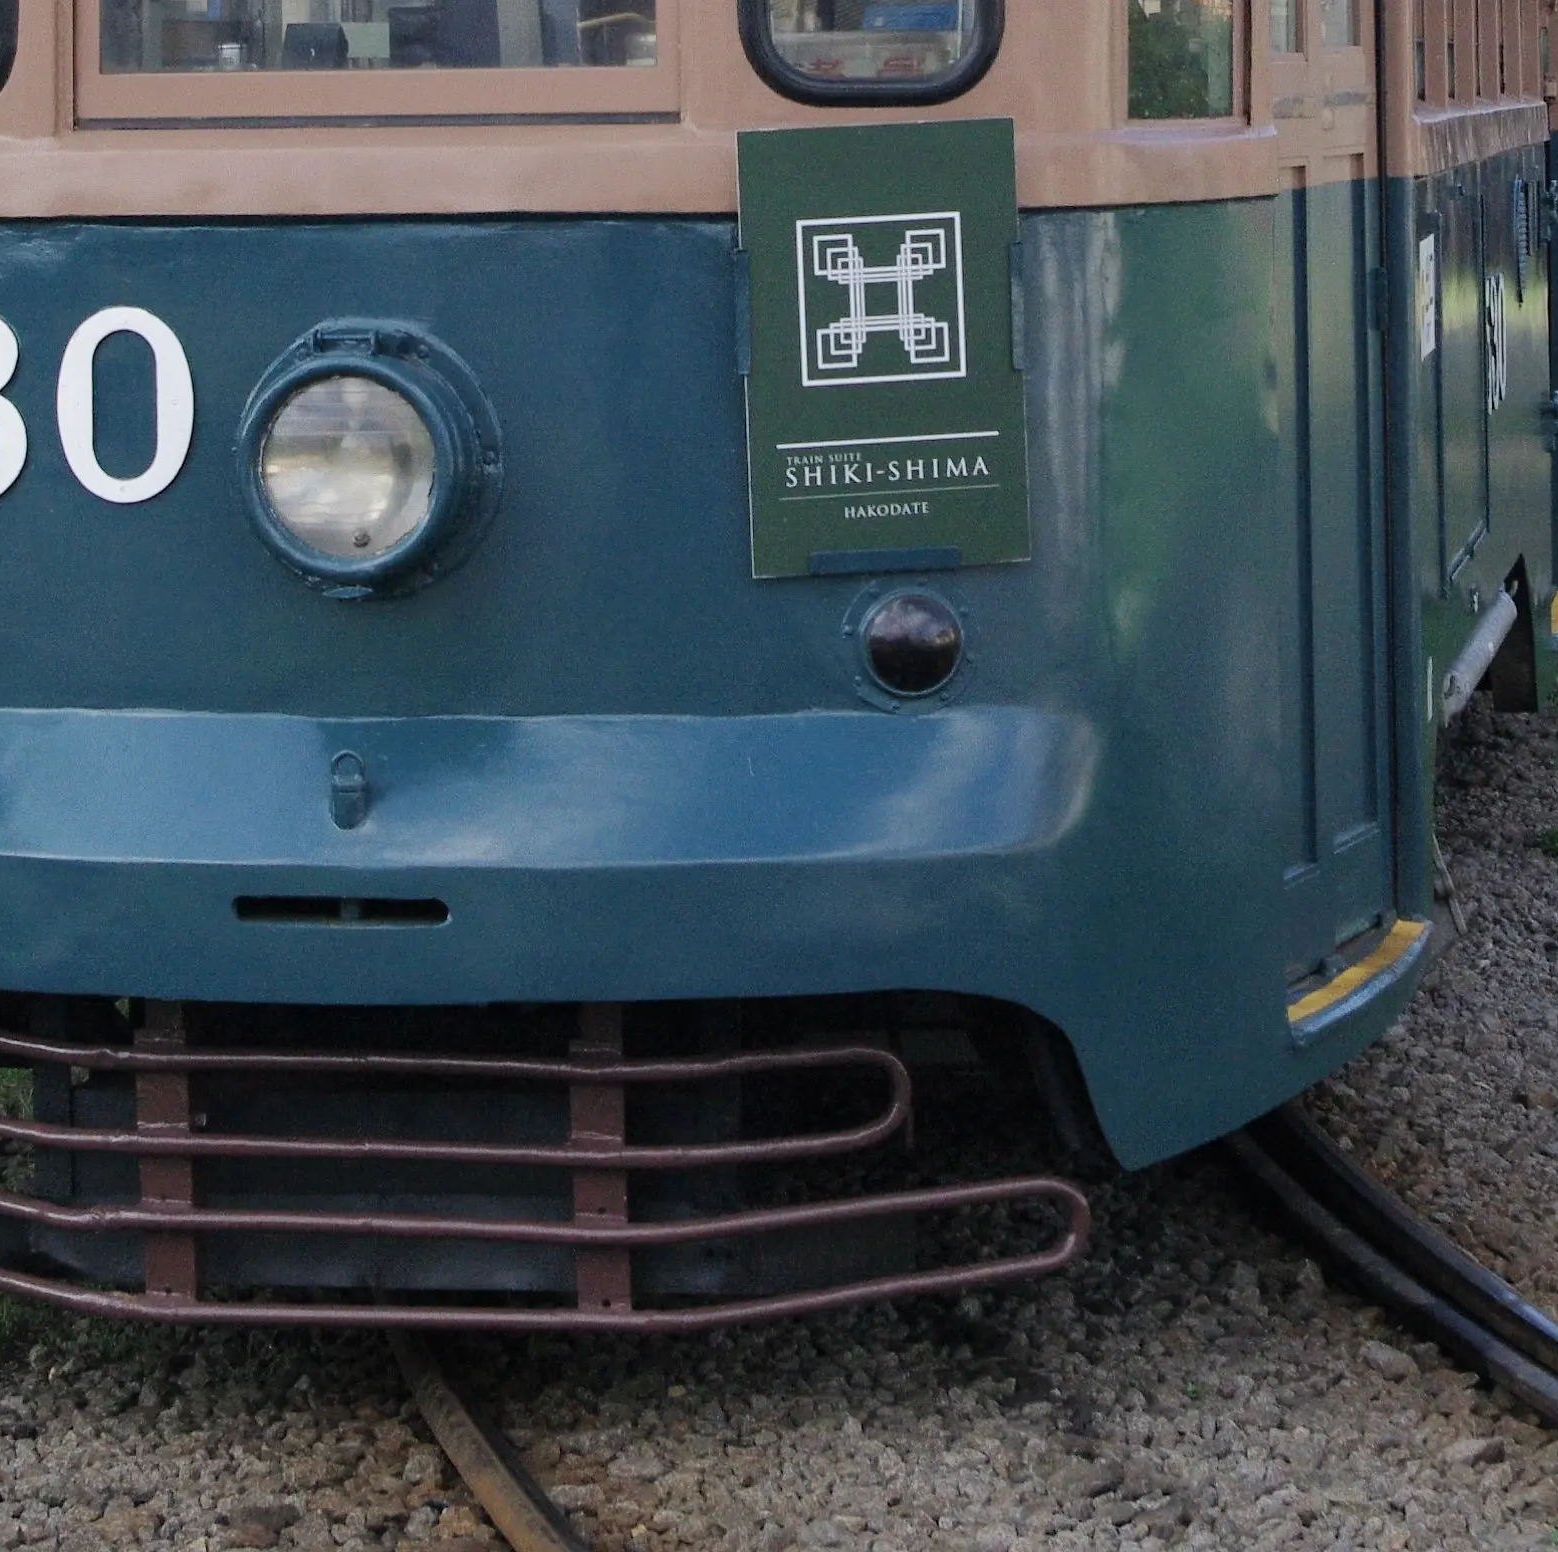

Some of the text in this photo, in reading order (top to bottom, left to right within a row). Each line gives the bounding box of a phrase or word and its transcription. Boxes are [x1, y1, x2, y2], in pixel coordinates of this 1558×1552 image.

[786, 452, 863, 466] TRAIN SUITE
[785, 456, 990, 488] SHIKI-SHIMA
[844, 501, 930, 519] HAKODATE
